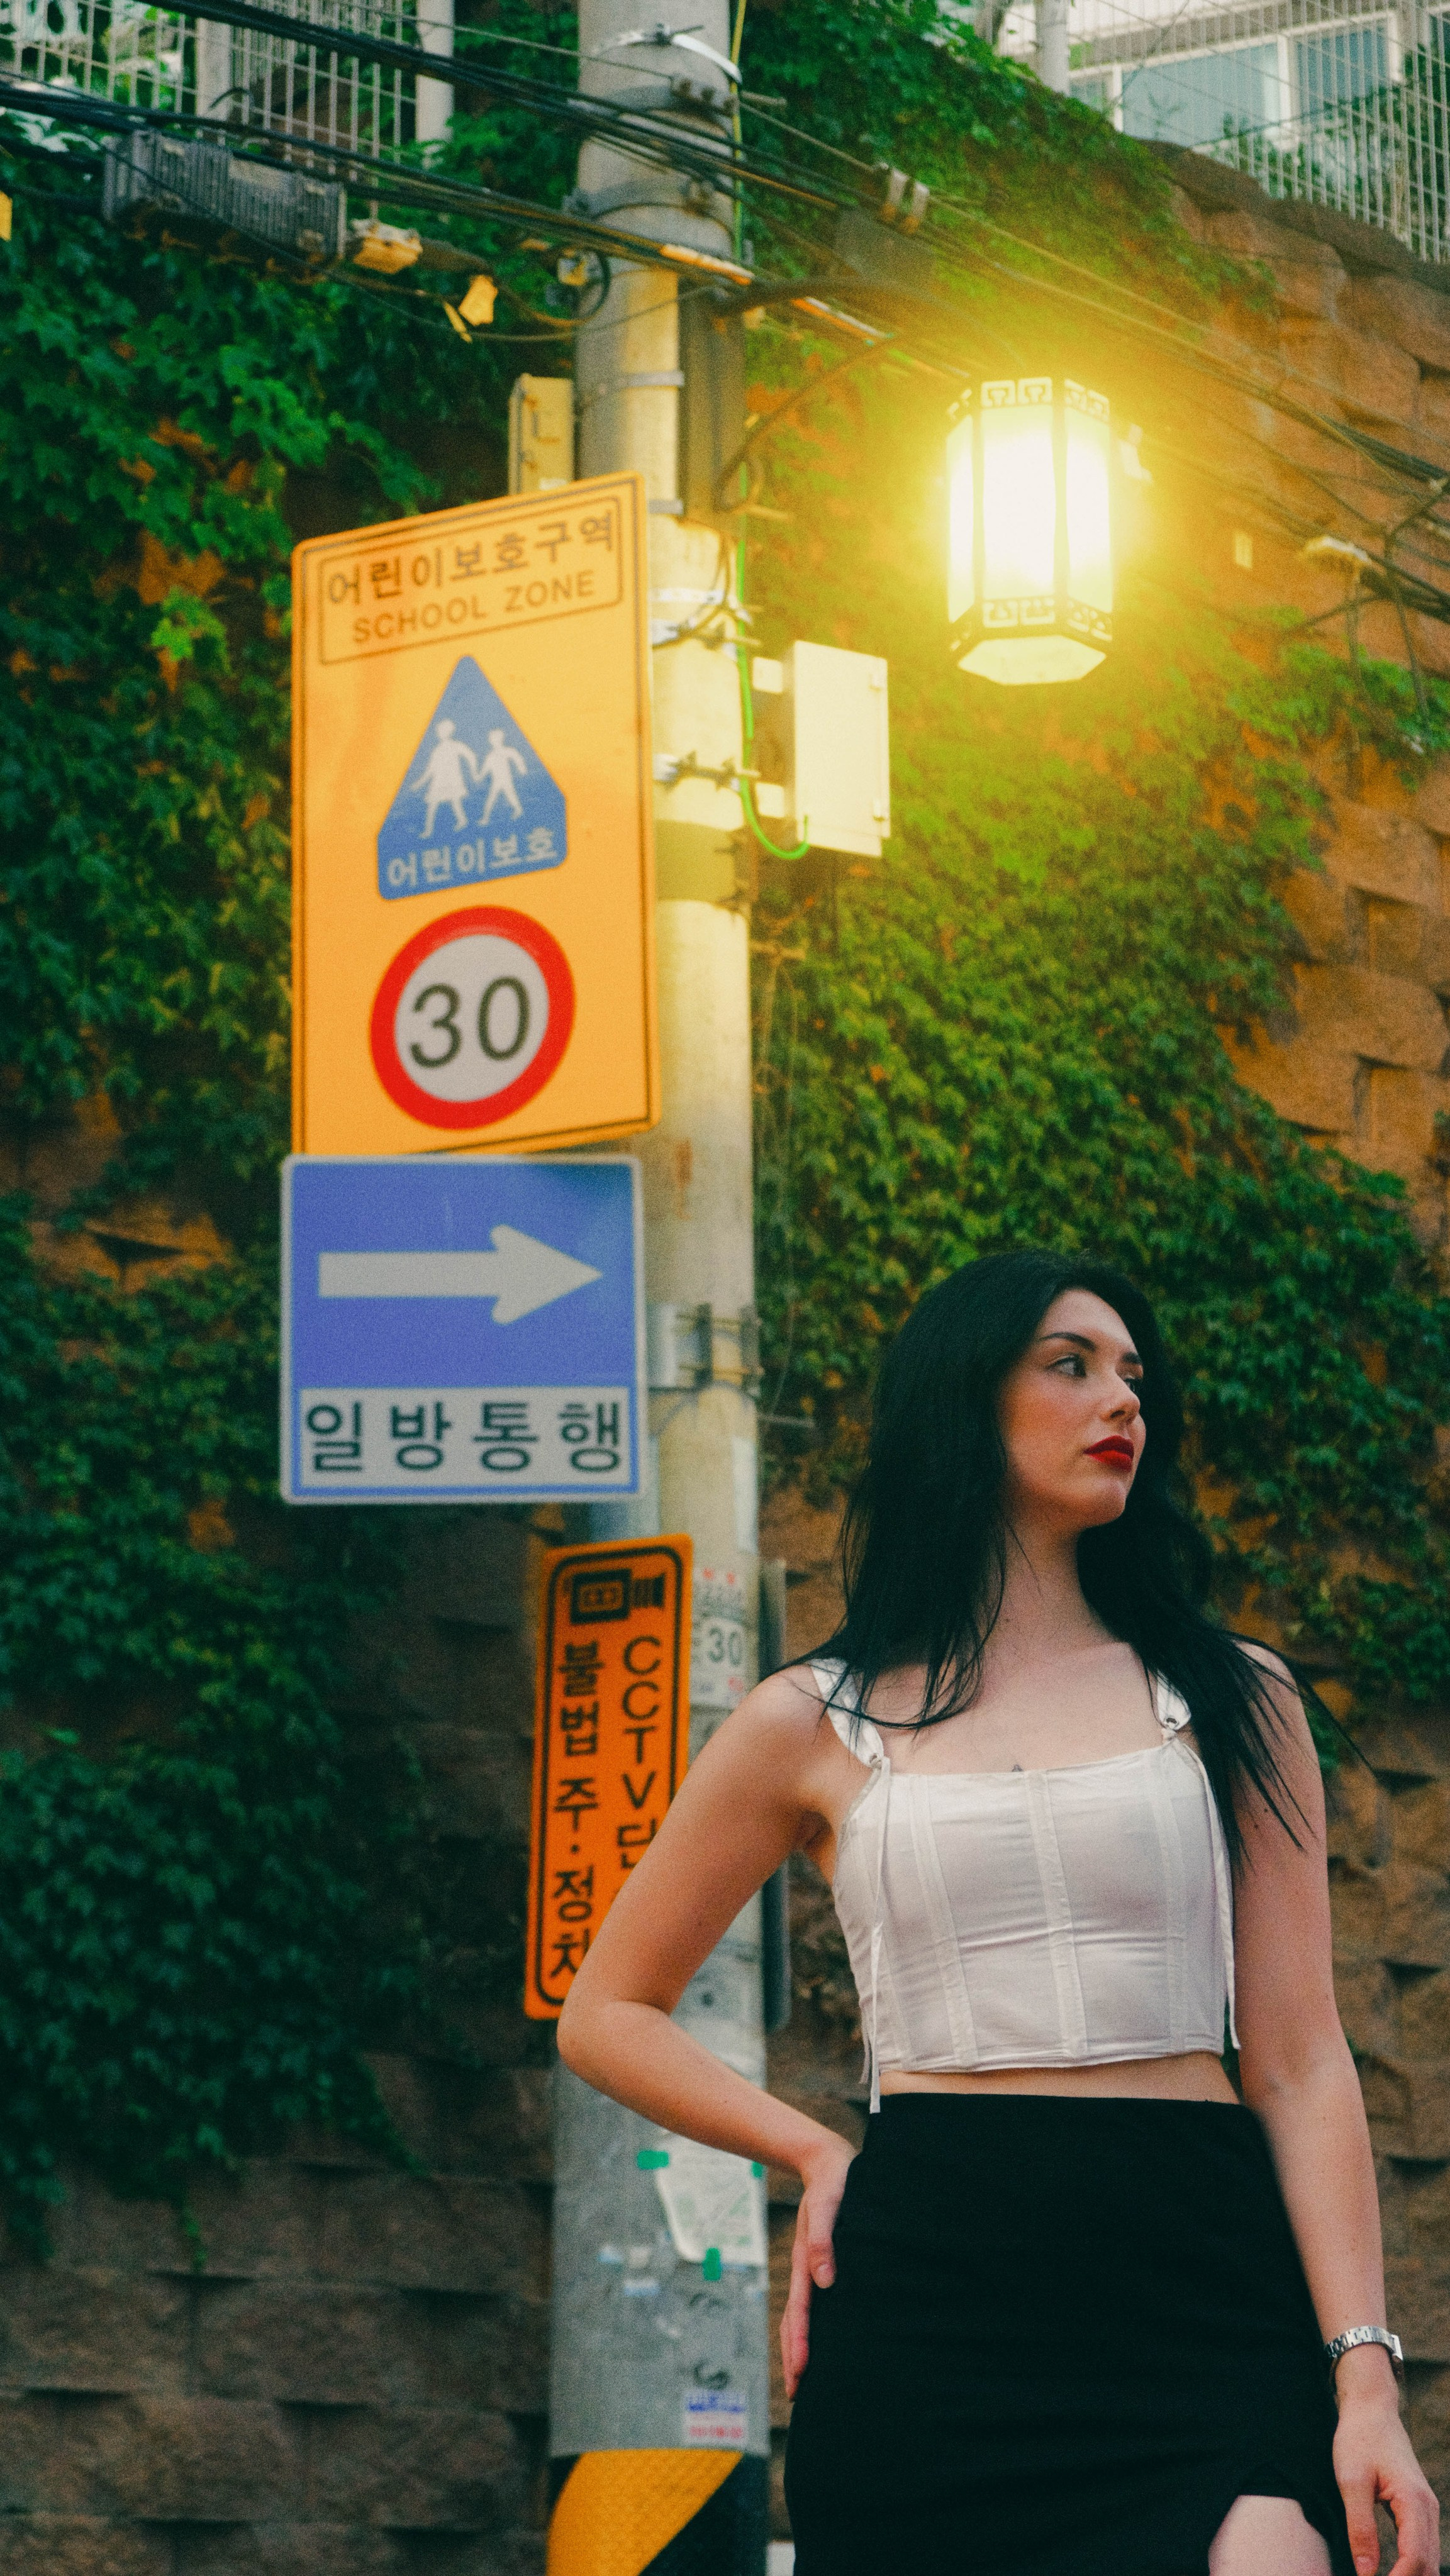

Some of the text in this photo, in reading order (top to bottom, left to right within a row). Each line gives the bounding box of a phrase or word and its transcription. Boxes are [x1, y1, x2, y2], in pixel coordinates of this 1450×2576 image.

[327, 508, 614, 605] 어린이보호구역
[352, 569, 595, 644] SCHOOL ZONE
[387, 827, 559, 887] 어린이보호
[409, 976, 530, 1069] 30
[306, 1400, 622, 1474] 일방통행
